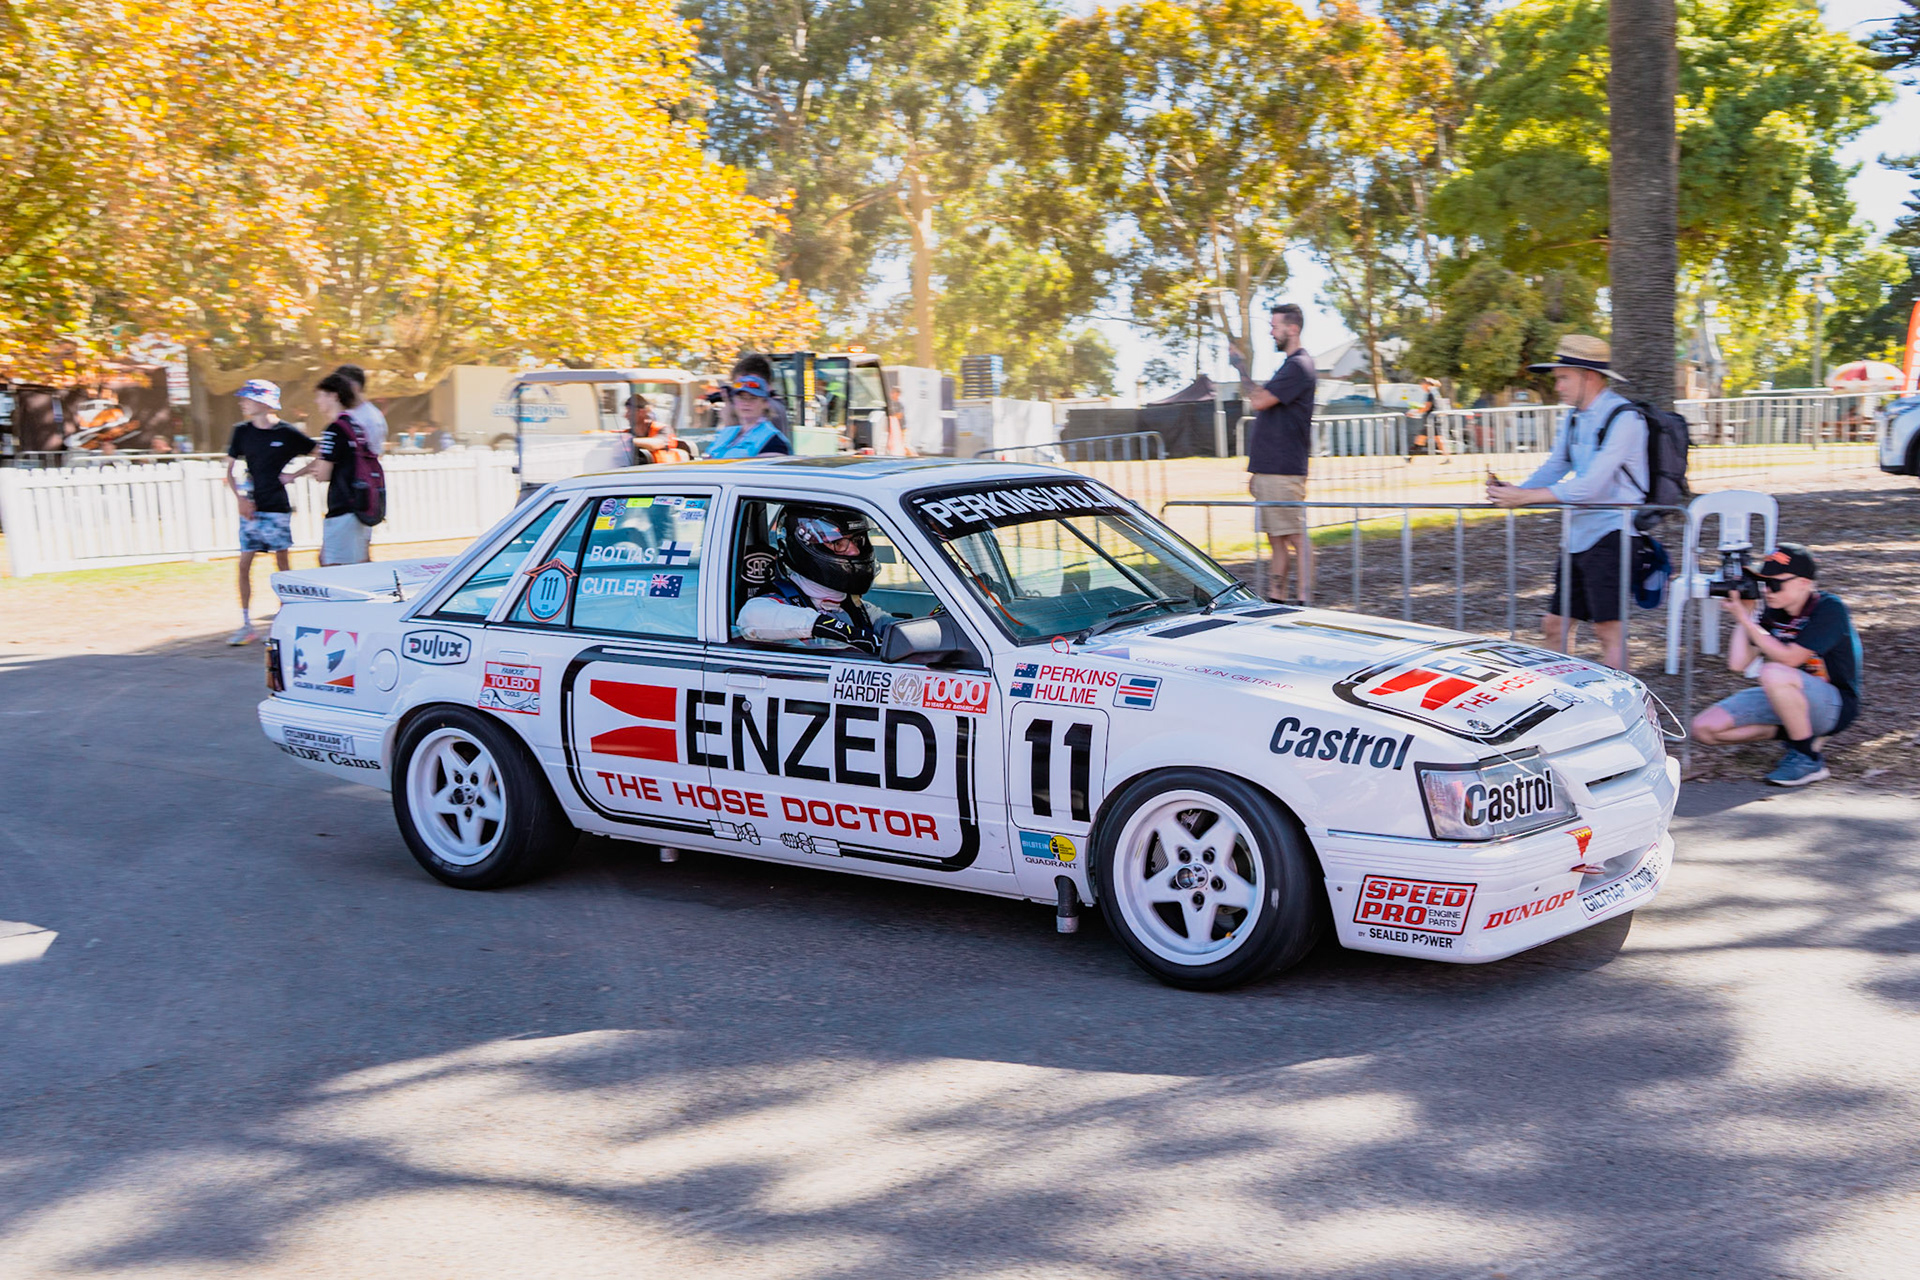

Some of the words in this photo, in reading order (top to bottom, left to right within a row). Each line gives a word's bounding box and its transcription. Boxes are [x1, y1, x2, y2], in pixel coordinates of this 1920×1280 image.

[590, 545, 655, 564] BOTTAS
[540, 576, 560, 601] 111
[581, 577, 647, 597] CUTLER
[489, 674, 535, 691] TOLEDO
[501, 667, 525, 676] FAMOUS
[836, 668, 893, 688] JAMES
[1039, 665, 1118, 687] PERKINS
[1135, 656, 1179, 668] Owner
[1184, 664, 1229, 678] COLIN
[1231, 673, 1294, 690] GILTRAP
[503, 690, 521, 698] TOOLS
[834, 684, 890, 704] HARDIE
[925, 676, 985, 706] 1000
[1035, 683, 1098, 704] HULME
[1453, 691, 1499, 714] THE
[686, 688, 938, 792] ENZED
[1269, 716, 1416, 770] Castrol
[328, 752, 382, 770] Cams
[1025, 718, 1093, 823] 11
[597, 771, 663, 802] THE
[672, 782, 769, 818] HOSE
[781, 797, 940, 841] DOCTOR
[1463, 770, 1555, 827] Castrol
[1022, 840, 1050, 850] BILSTEIN
[1025, 857, 1078, 869] QUADRANT
[1365, 880, 1468, 907] SPEED
[1582, 883, 1626, 912] GILTRAP
[1361, 901, 1428, 925] PRO
[1428, 909, 1462, 919] ENGINE
[1483, 889, 1577, 930] DUNLOP
[1428, 917, 1458, 928] PARTS
[1369, 927, 1409, 943] SEALED
[1412, 933, 1454, 949] POWER
